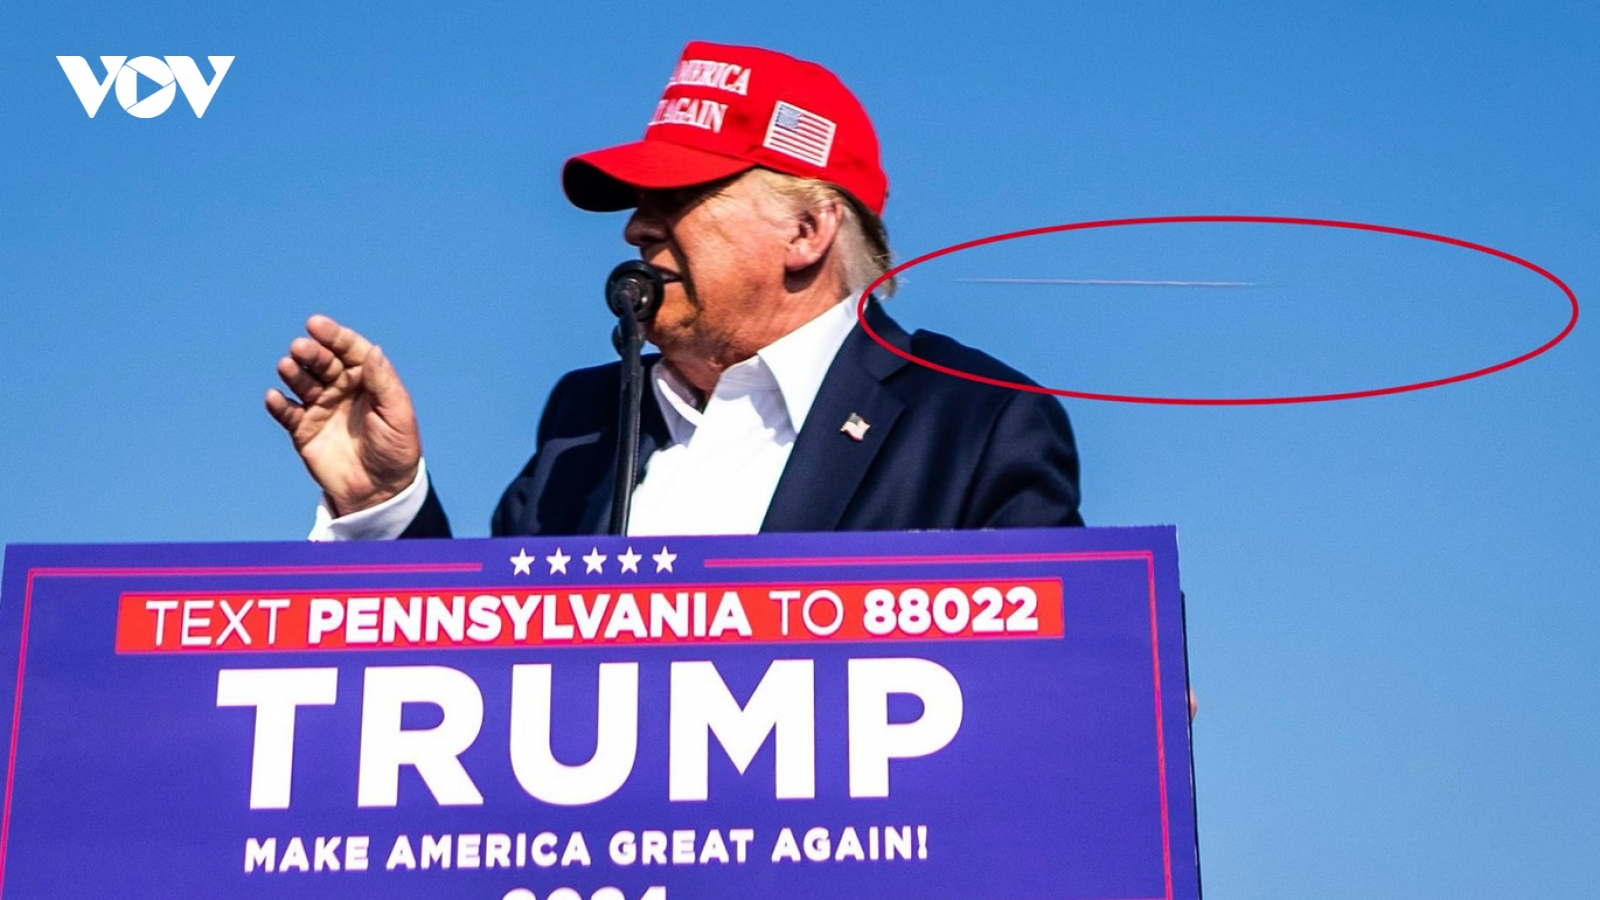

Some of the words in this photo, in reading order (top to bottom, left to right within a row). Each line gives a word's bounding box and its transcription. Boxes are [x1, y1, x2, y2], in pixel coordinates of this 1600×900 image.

[145, 599, 292, 647] TEXT
[307, 592, 753, 645] PENNSYLVANIA
[768, 589, 845, 637] TO
[862, 586, 1040, 635] 88022
[216, 657, 965, 811] TRUMP
[243, 836, 371, 874] MAKE
[386, 831, 592, 871] AMERICA
[608, 828, 755, 866] GREAT
[770, 825, 929, 864] AGAIN!
